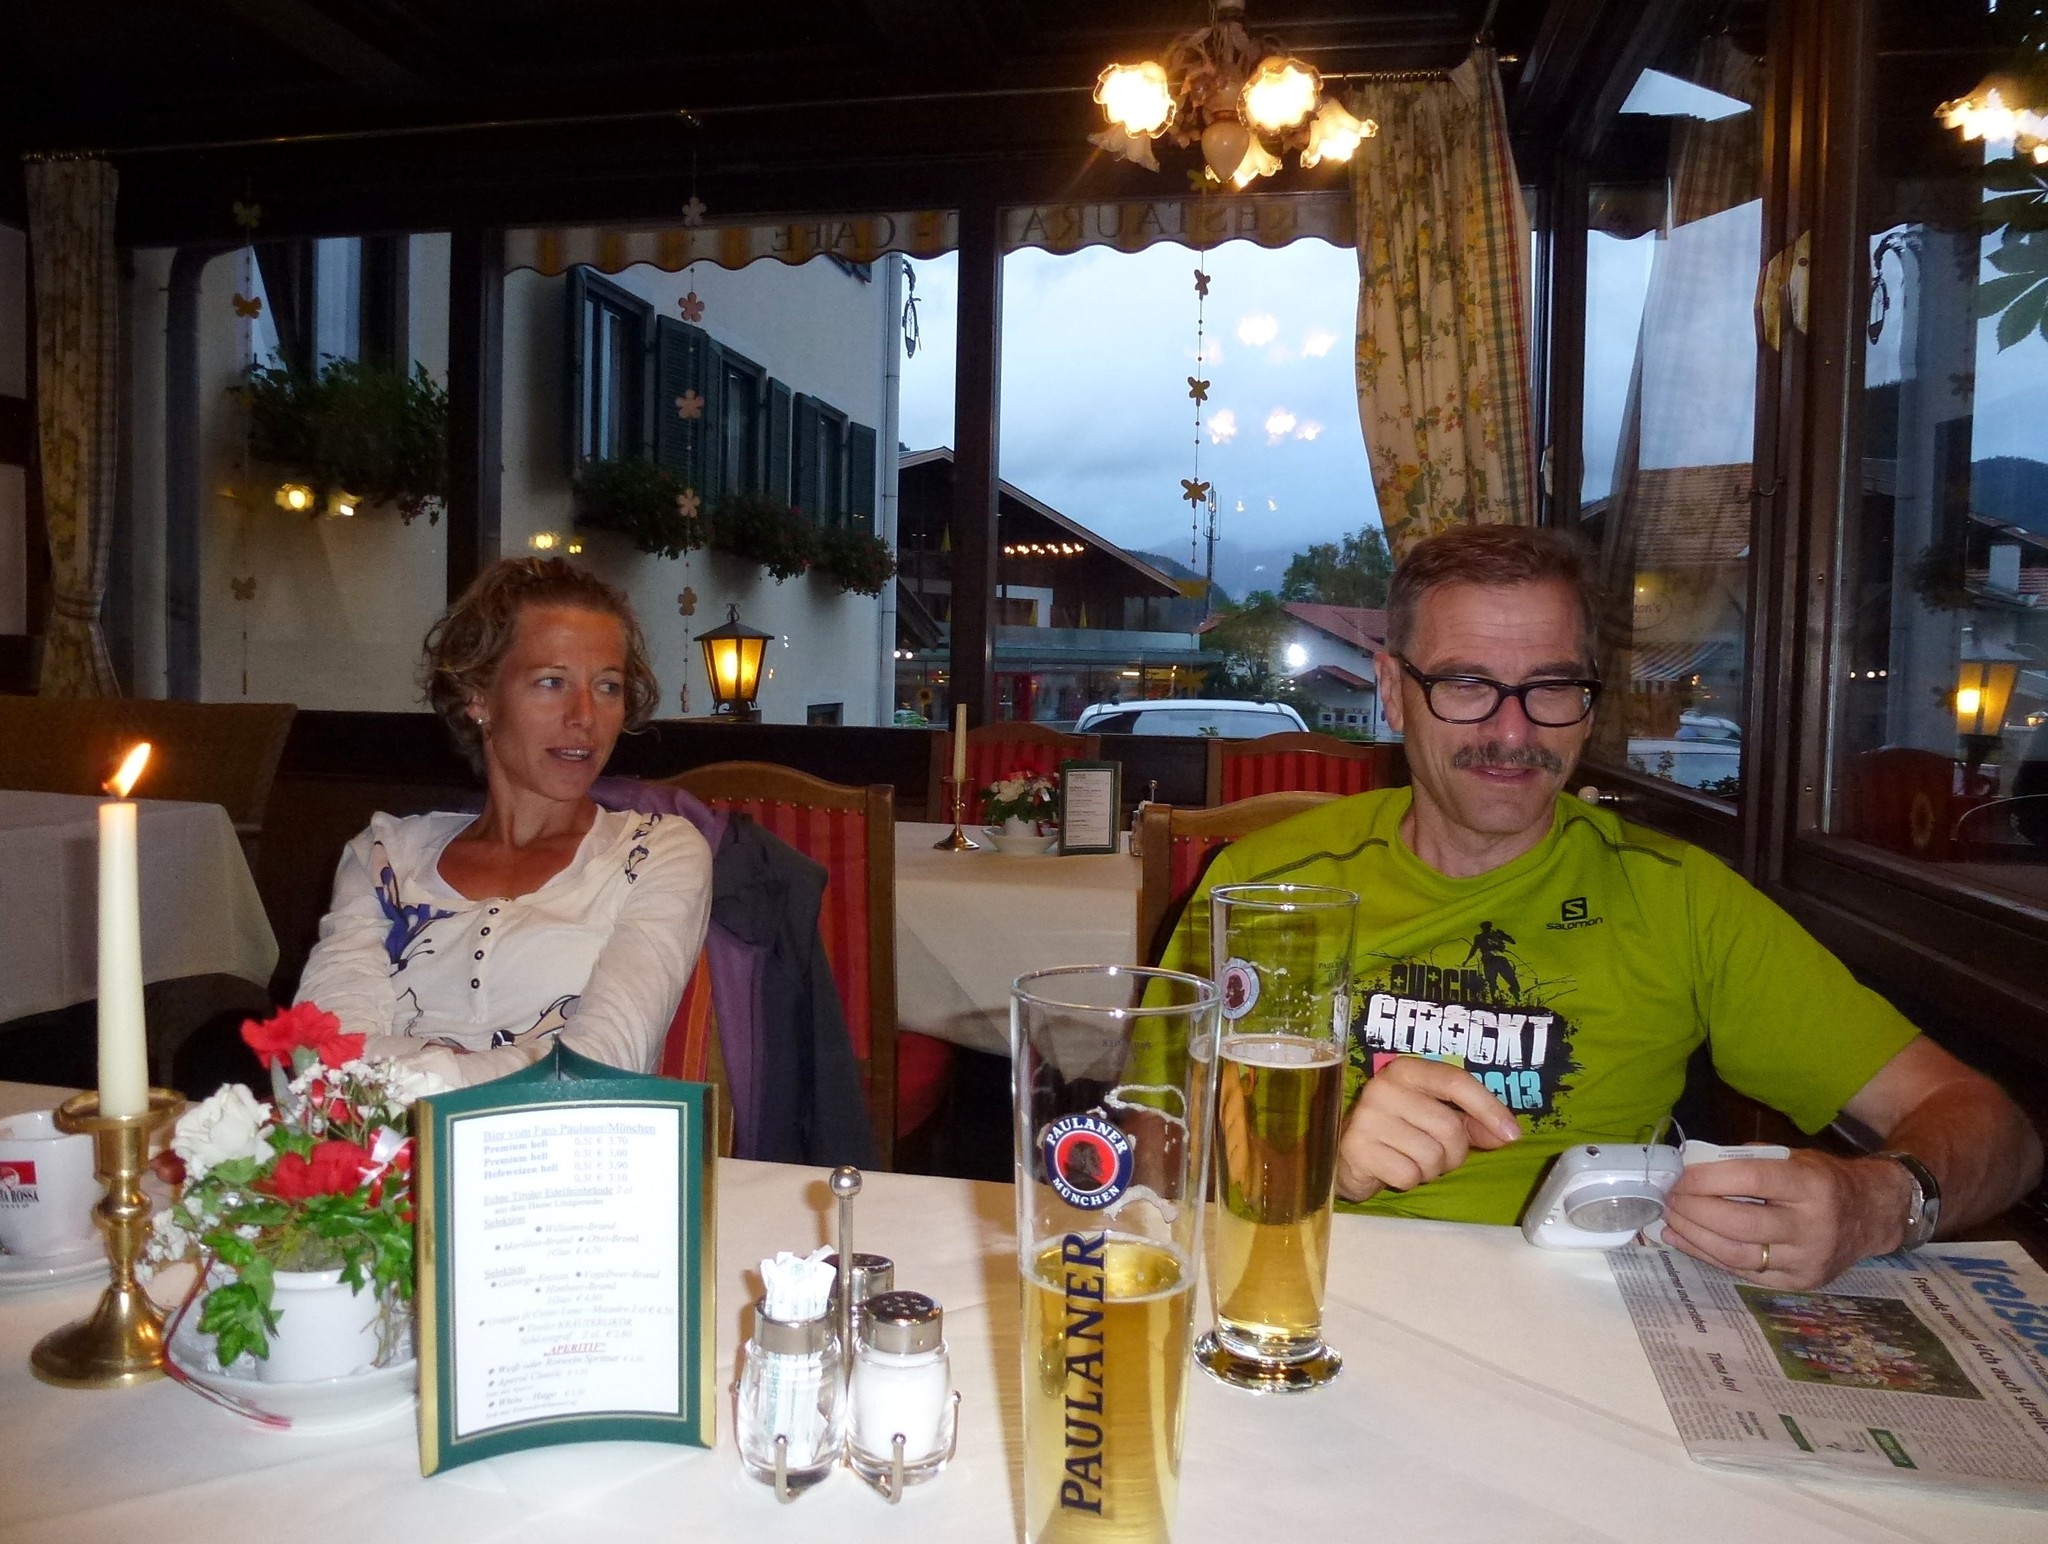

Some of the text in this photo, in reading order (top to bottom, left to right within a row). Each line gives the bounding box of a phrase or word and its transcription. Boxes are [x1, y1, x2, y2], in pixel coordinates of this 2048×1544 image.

[1391, 963, 1479, 1001] DURCH
[1365, 993, 1554, 1070] GEROCKT
[1046, 1117, 1129, 1155] PAULANER
[484, 1143, 528, 1155] Premium
[530, 1139, 549, 1150] hell
[484, 1155, 528, 1168] Premium
[530, 1152, 549, 1162] hell
[484, 1166, 538, 1180] Hefeweizen
[540, 1163, 558, 1173] hell
[10, 1189, 41, 1203] ROSSA
[512, 1190, 542, 1202] Tiroler
[1052, 1177, 1121, 1206] MÜNCHEN
[484, 1215, 526, 1230] Selektion
[484, 1265, 526, 1280] Selektion
[1911, 1276, 1949, 1312] Freunde
[1971, 1340, 2003, 1365] sich
[1990, 1366, 2026, 1398] auch
[1061, 1231, 1105, 1517] PAULANER
